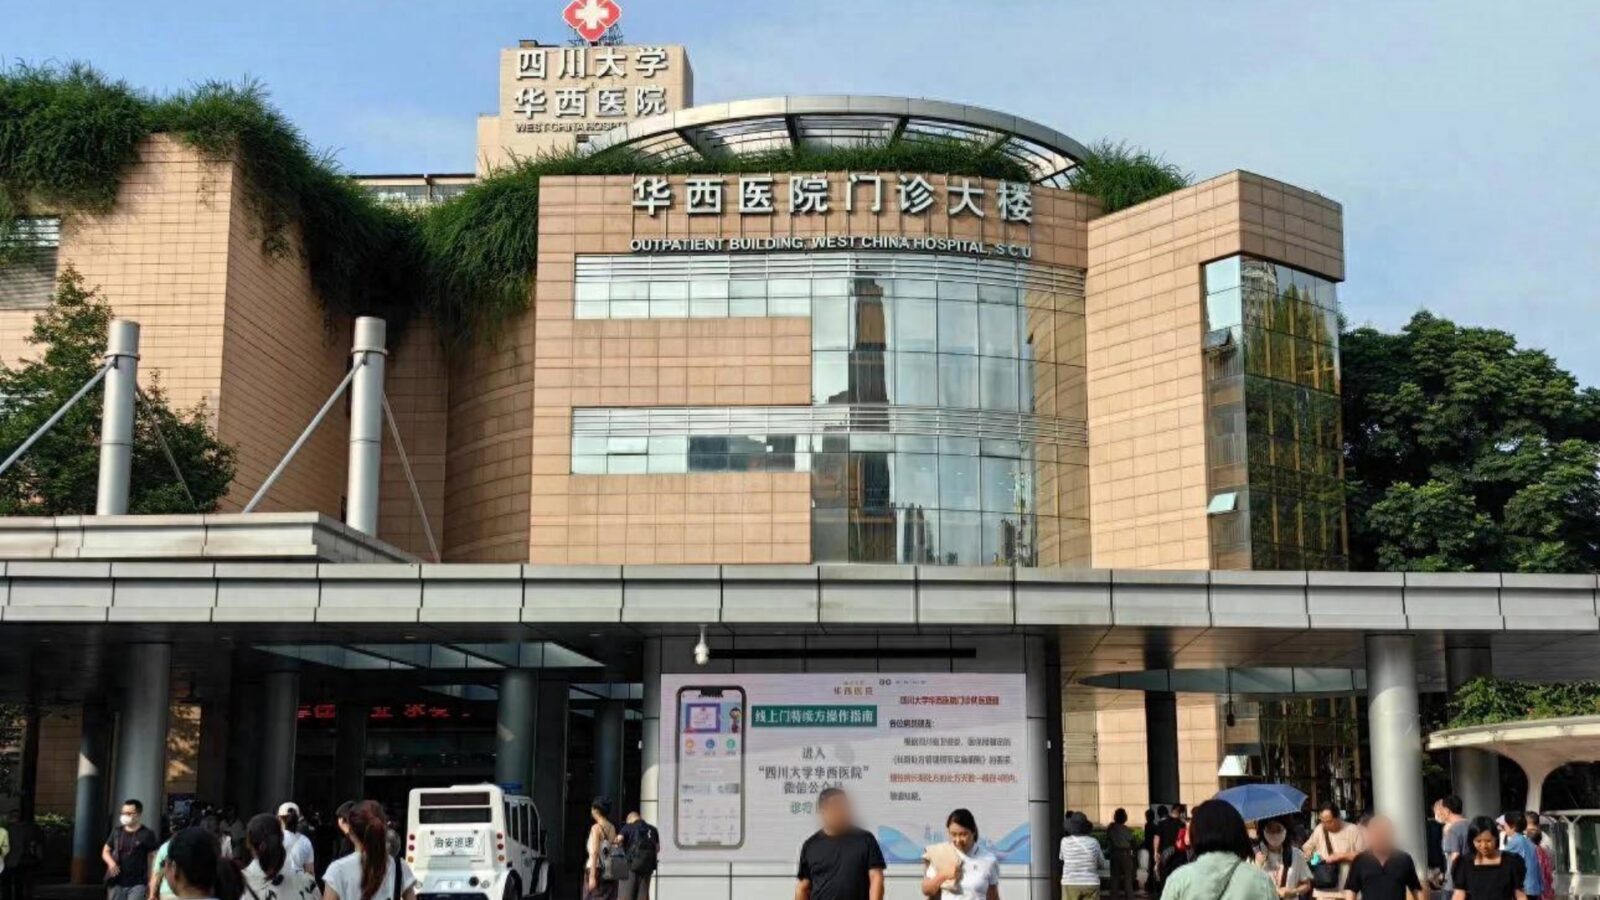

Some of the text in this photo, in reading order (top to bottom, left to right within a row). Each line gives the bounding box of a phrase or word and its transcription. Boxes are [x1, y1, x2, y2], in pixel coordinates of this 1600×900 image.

[516, 47, 668, 80] 四川大学
[514, 86, 667, 118] 华西医院
[516, 123, 549, 132] WEST
[551, 123, 585, 132] CHINA
[632, 174, 1032, 223] 华西医院门诊大楼
[630, 239, 723, 251] OUTPATIENT
[811, 236, 855, 248] WEST
[861, 236, 909, 248] CHINA
[802, 746, 826, 760] 进入
[434, 836, 474, 849] 治安巡逻
